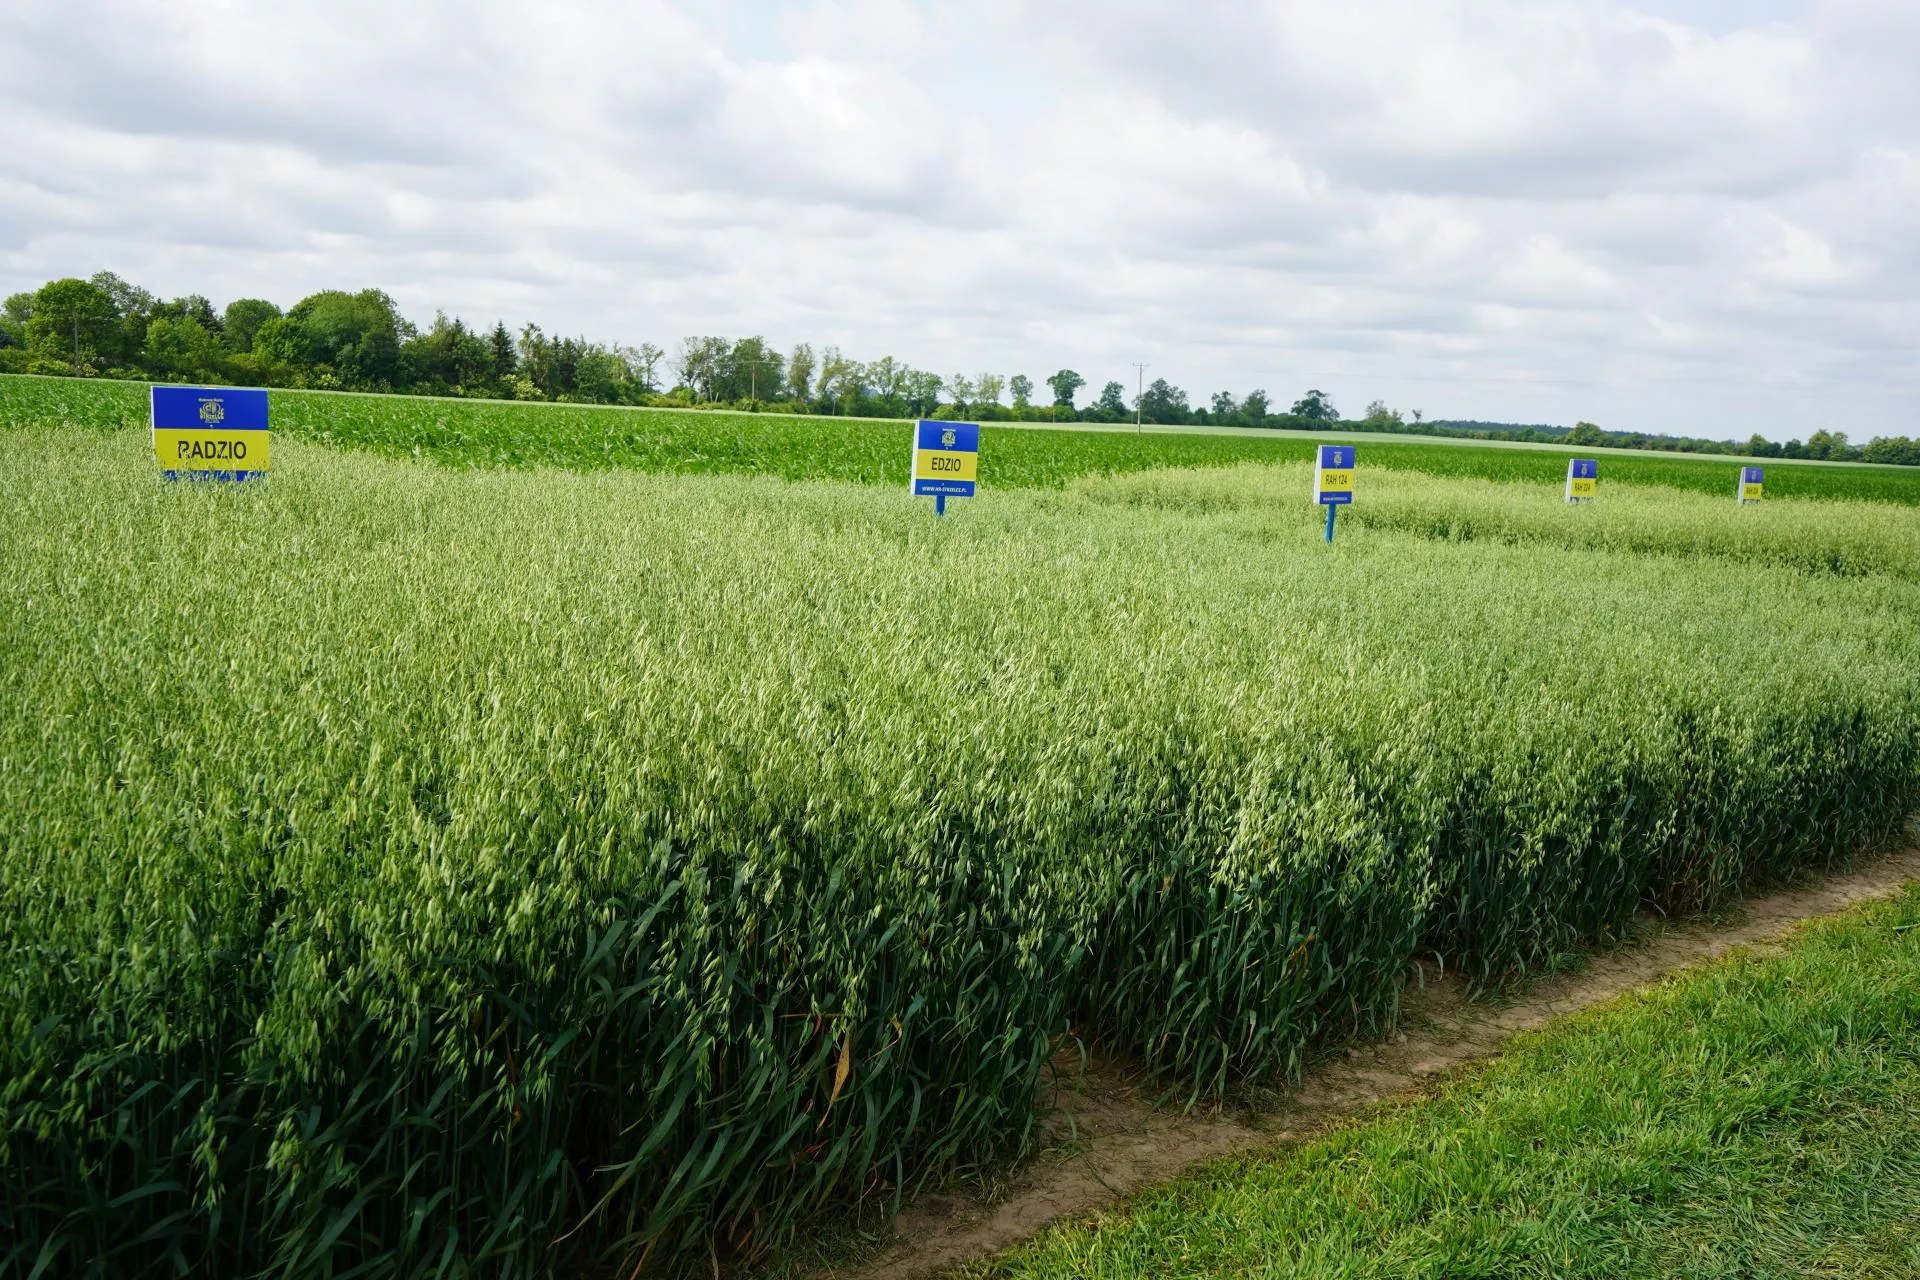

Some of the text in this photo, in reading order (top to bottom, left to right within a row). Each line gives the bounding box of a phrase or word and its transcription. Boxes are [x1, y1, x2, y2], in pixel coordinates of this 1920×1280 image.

[178, 440, 247, 459] RADZIO
[931, 457, 961, 472] EDZIO
[1326, 474, 1348, 485] RAH 124
